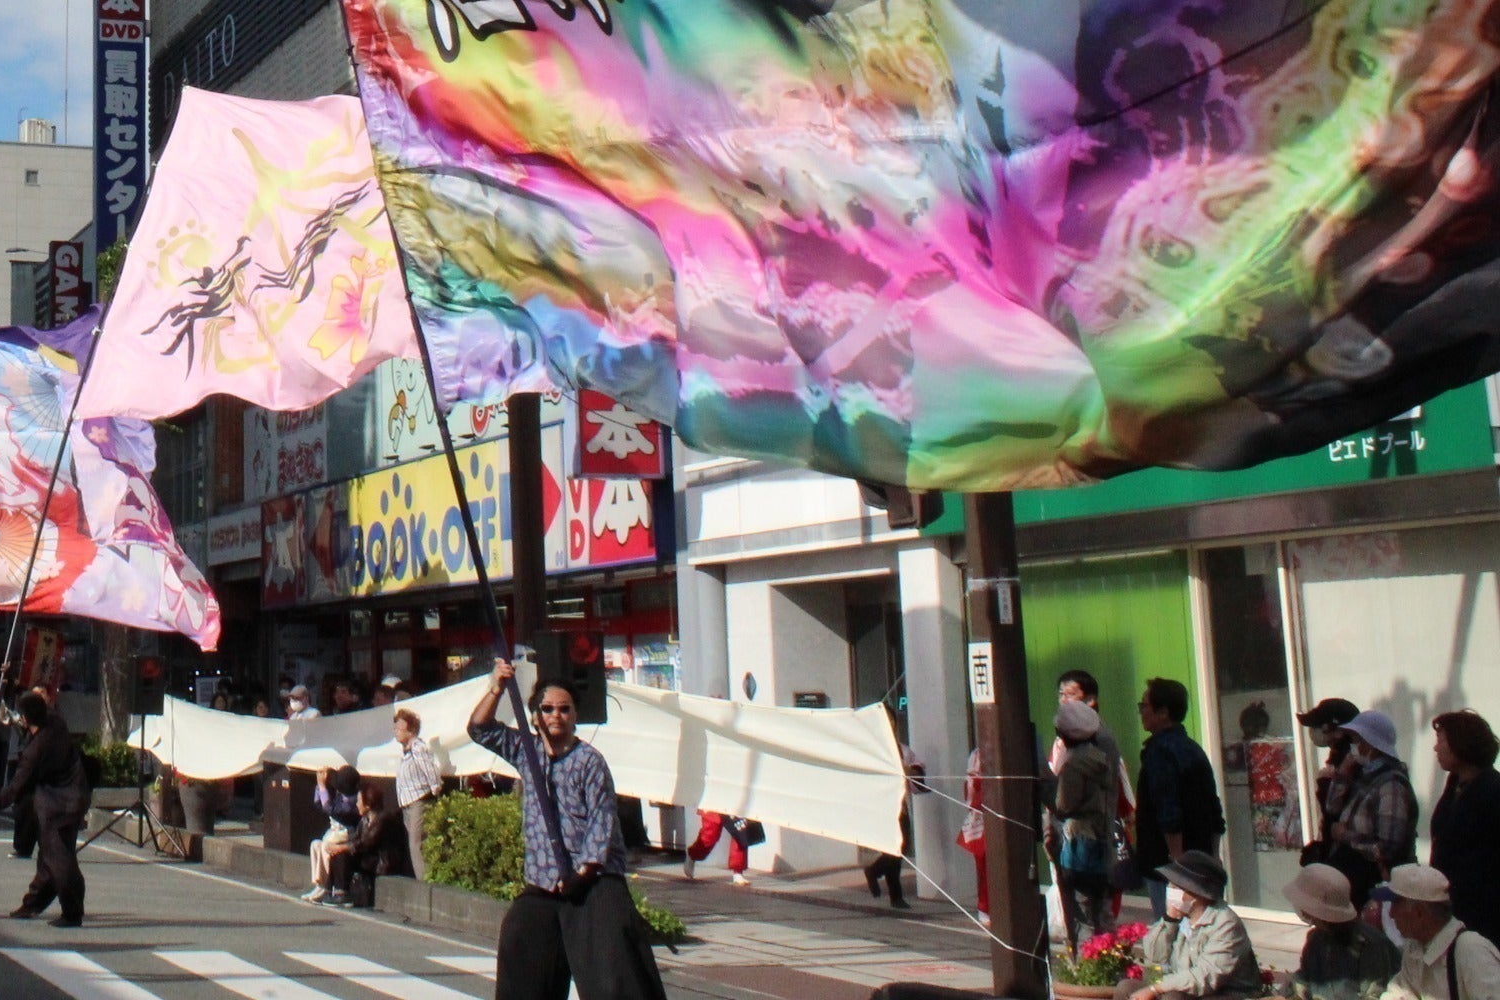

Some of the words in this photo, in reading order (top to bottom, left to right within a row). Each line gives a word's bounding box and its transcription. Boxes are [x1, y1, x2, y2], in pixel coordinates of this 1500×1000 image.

[101, 22, 141, 41] DVD
[55, 245, 80, 328] GAM
[586, 403, 655, 460] 本
[1328, 430, 1425, 462] ピエドプール
[568, 480, 586, 561] VD
